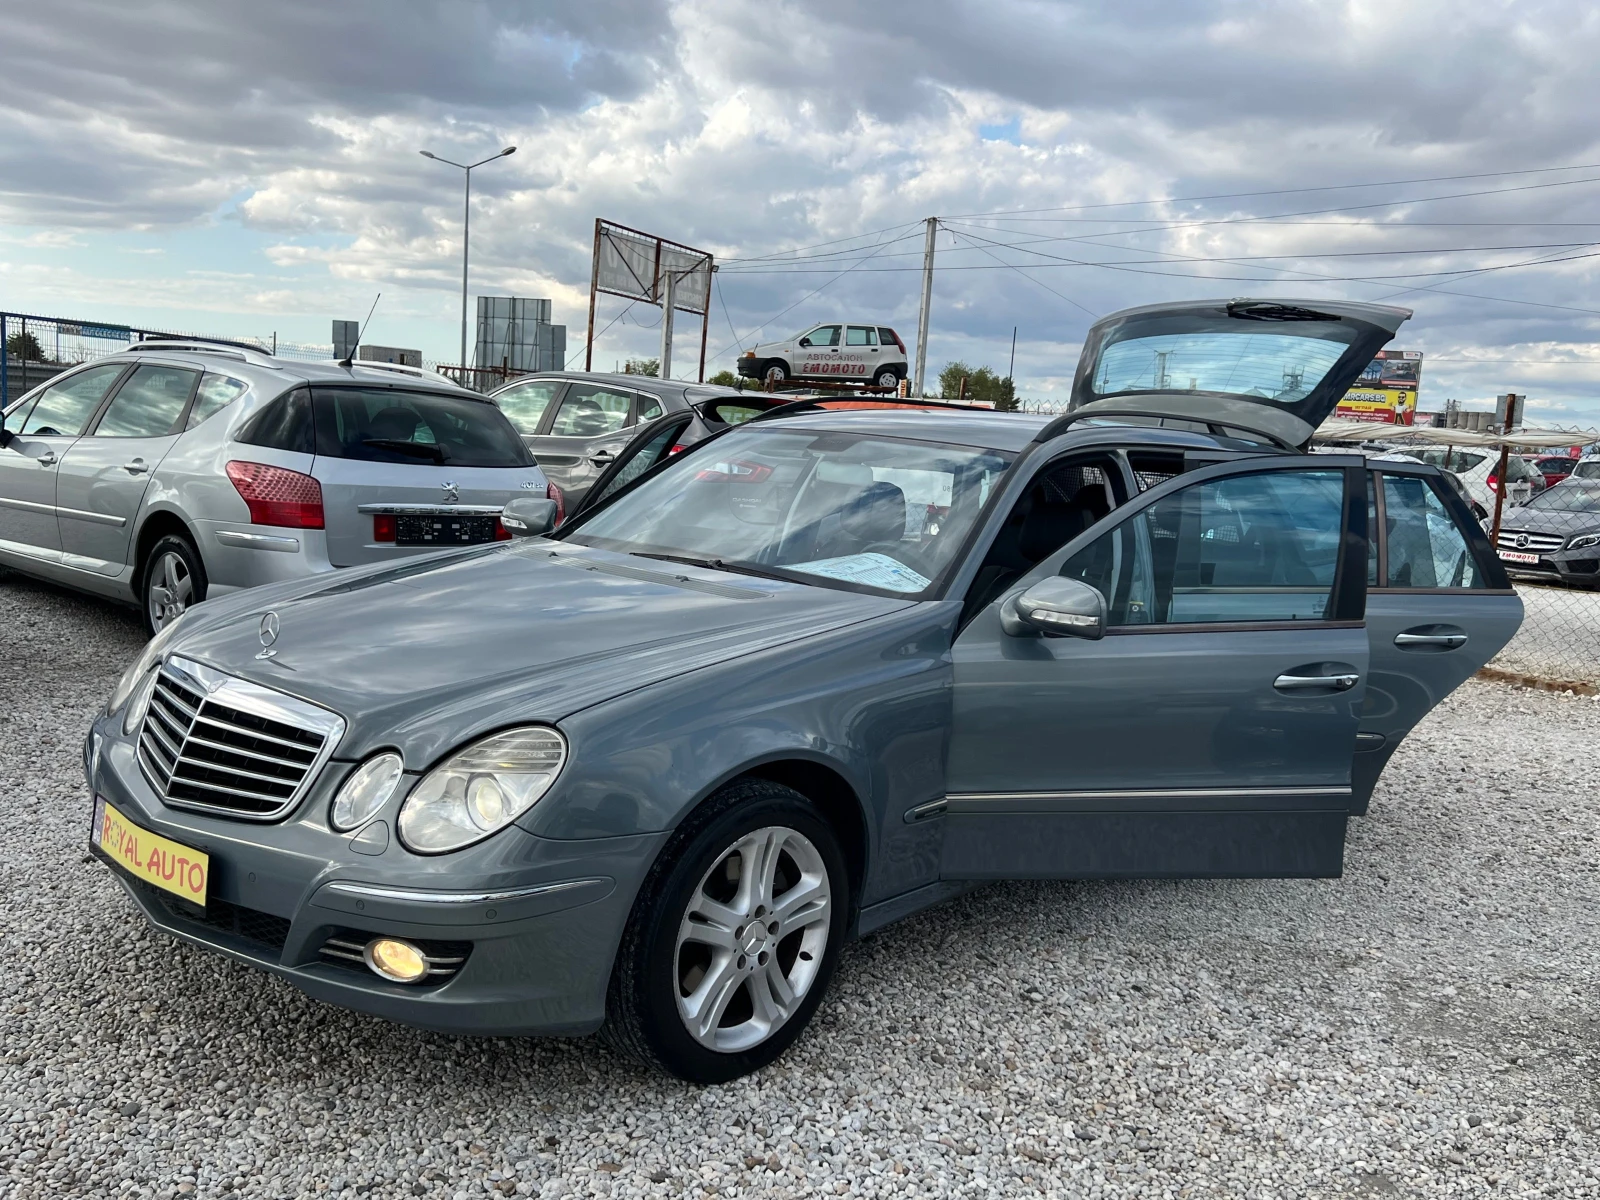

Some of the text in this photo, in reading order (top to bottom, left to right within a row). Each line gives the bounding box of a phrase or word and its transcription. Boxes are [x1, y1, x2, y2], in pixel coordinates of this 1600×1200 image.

[520, 480, 535, 489] 407
[103, 813, 205, 894] ROYAL AUTO
